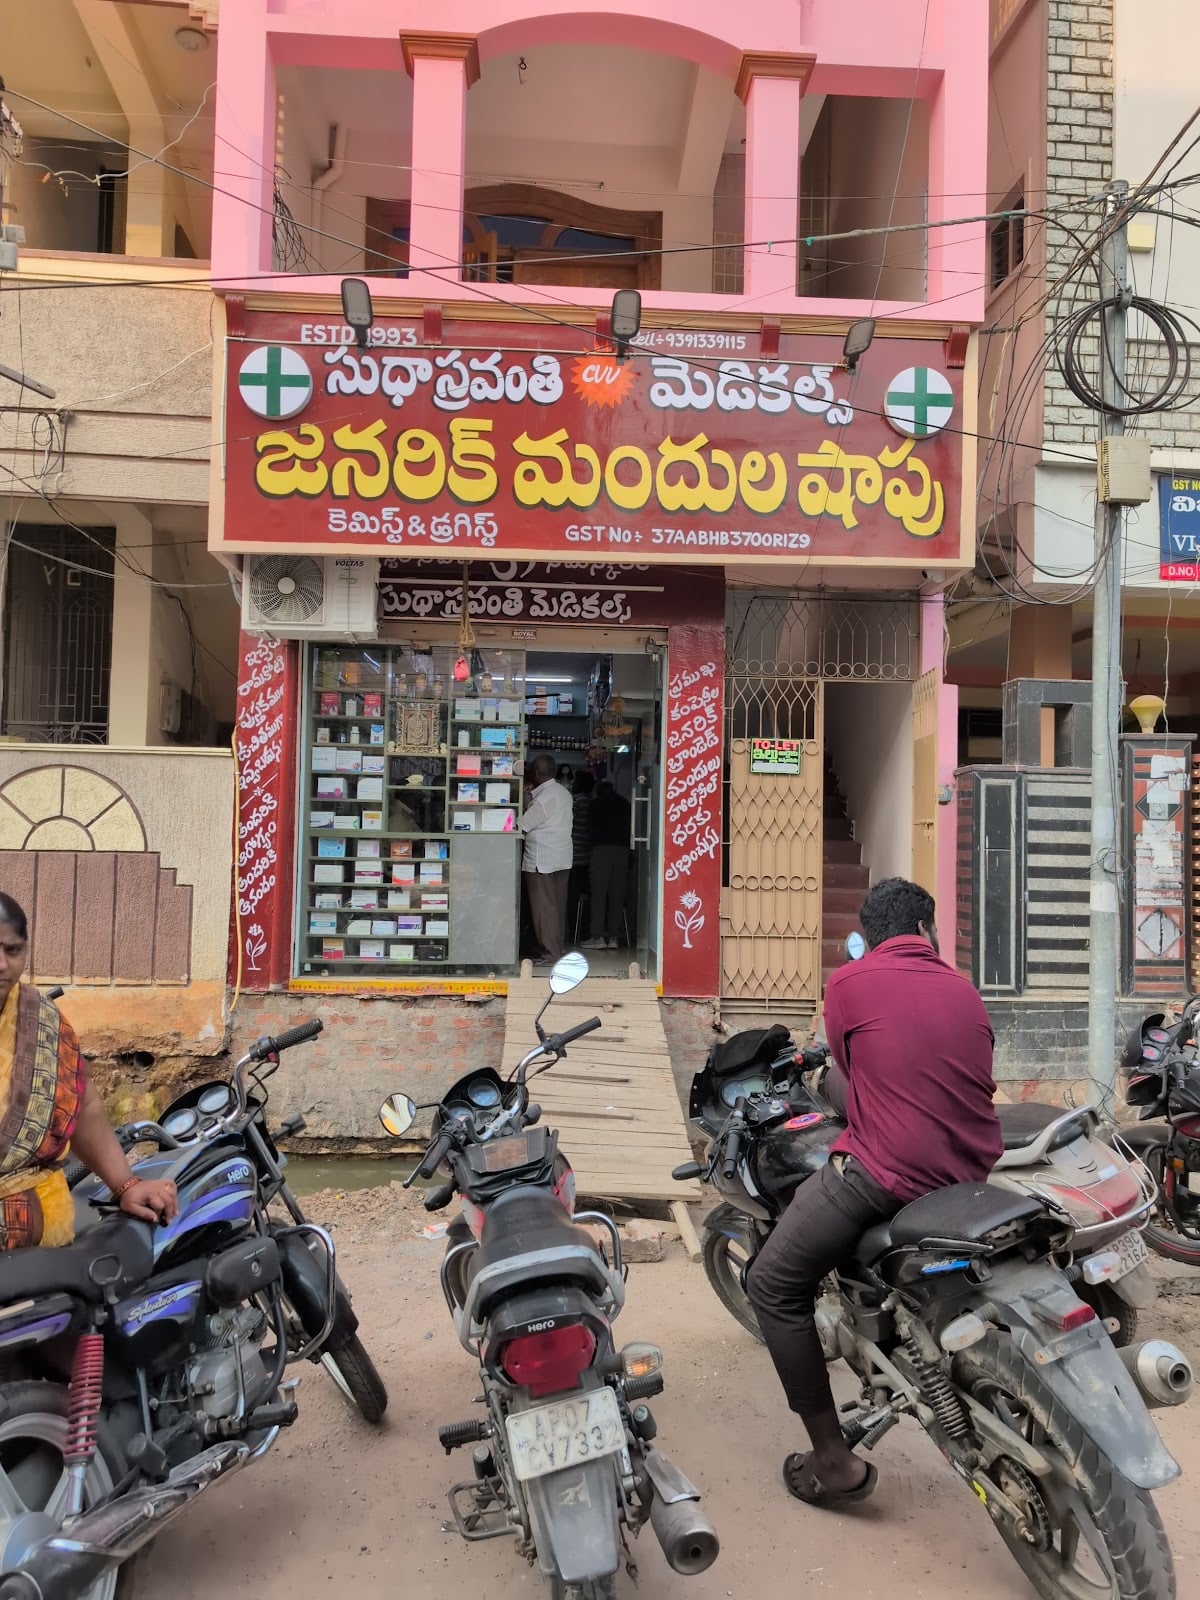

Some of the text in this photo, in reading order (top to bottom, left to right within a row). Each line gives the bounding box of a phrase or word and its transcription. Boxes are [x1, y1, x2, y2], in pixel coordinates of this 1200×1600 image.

[300, 324, 355, 344] ESTD
[665, 333, 746, 350] 9391339115
[650, 357, 854, 425] మెడికల్స్
[256, 417, 945, 537] జనరిక్ మందుల షాపు
[1172, 479, 1190, 490] GST
[565, 525, 605, 542] GST
[529, 587, 632, 623] మెడికల్స్
[527, 1319, 555, 1333] Hero
